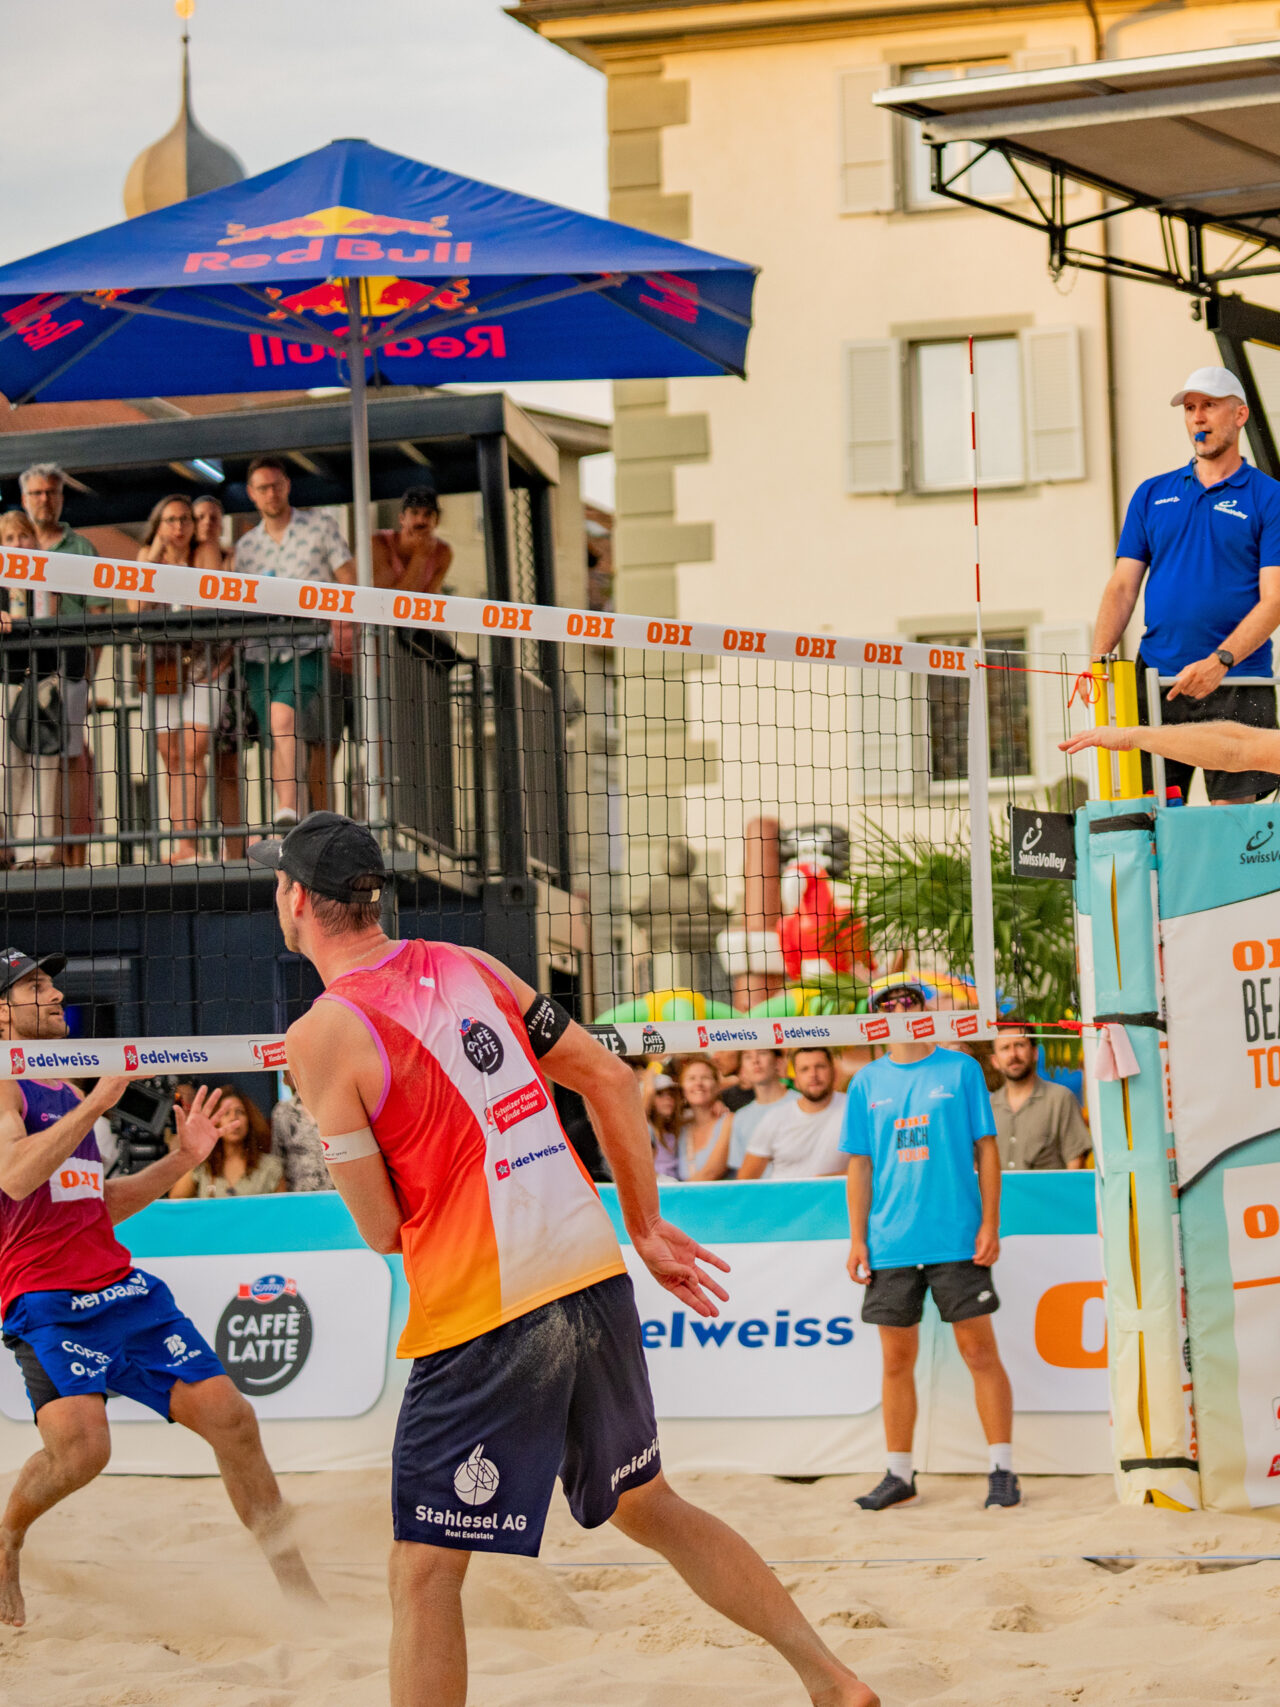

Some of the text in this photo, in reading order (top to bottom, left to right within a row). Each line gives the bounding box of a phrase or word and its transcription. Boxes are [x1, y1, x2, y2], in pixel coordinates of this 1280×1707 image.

[183, 238, 472, 273] Red Bull
[0, 553, 966, 671] BI OBI OBI OBI OBI OBI OBI OBI OBI OBI OBI OBI
[1018, 850, 1067, 873] SwissVolley
[709, 1026, 830, 1042] edelweiss edelweiss
[27, 1049, 209, 1068] edelweiss edelweiss
[897, 1126, 929, 1149] BEACH
[511, 1142, 567, 1170] edelweiss
[897, 1146, 930, 1163] TOUR
[227, 1305, 301, 1338] CAFFÈ
[642, 1309, 855, 1350] elweiss
[227, 1338, 299, 1363] LATTE
[415, 1505, 527, 1531] Stahlesel AG
[445, 1529, 494, 1540] Real Eselstate
